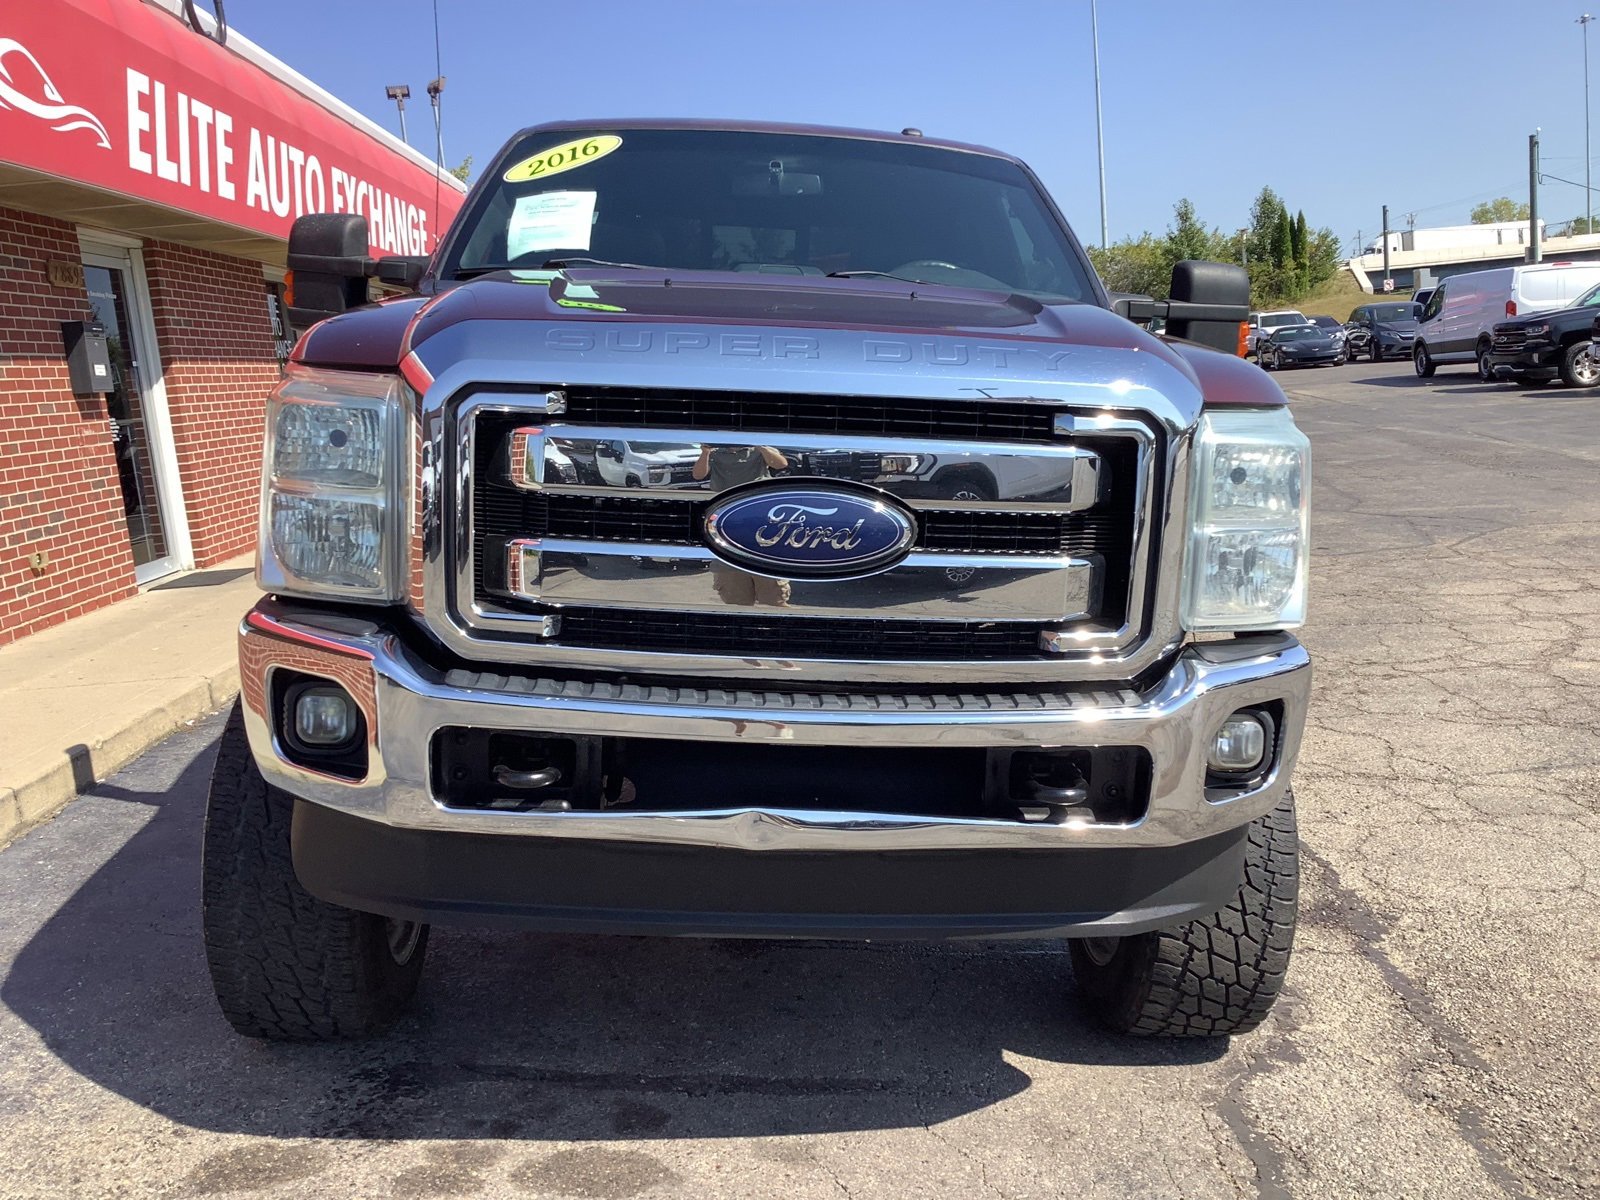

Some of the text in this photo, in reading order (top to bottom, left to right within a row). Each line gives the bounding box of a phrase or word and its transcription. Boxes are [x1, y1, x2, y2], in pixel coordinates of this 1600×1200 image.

[126, 67, 236, 201] ELITE
[246, 127, 326, 218] AUTO
[528, 139, 599, 177] 2016
[545, 327, 1073, 371] SUPER DUTY
[755, 503, 865, 550] Ford
